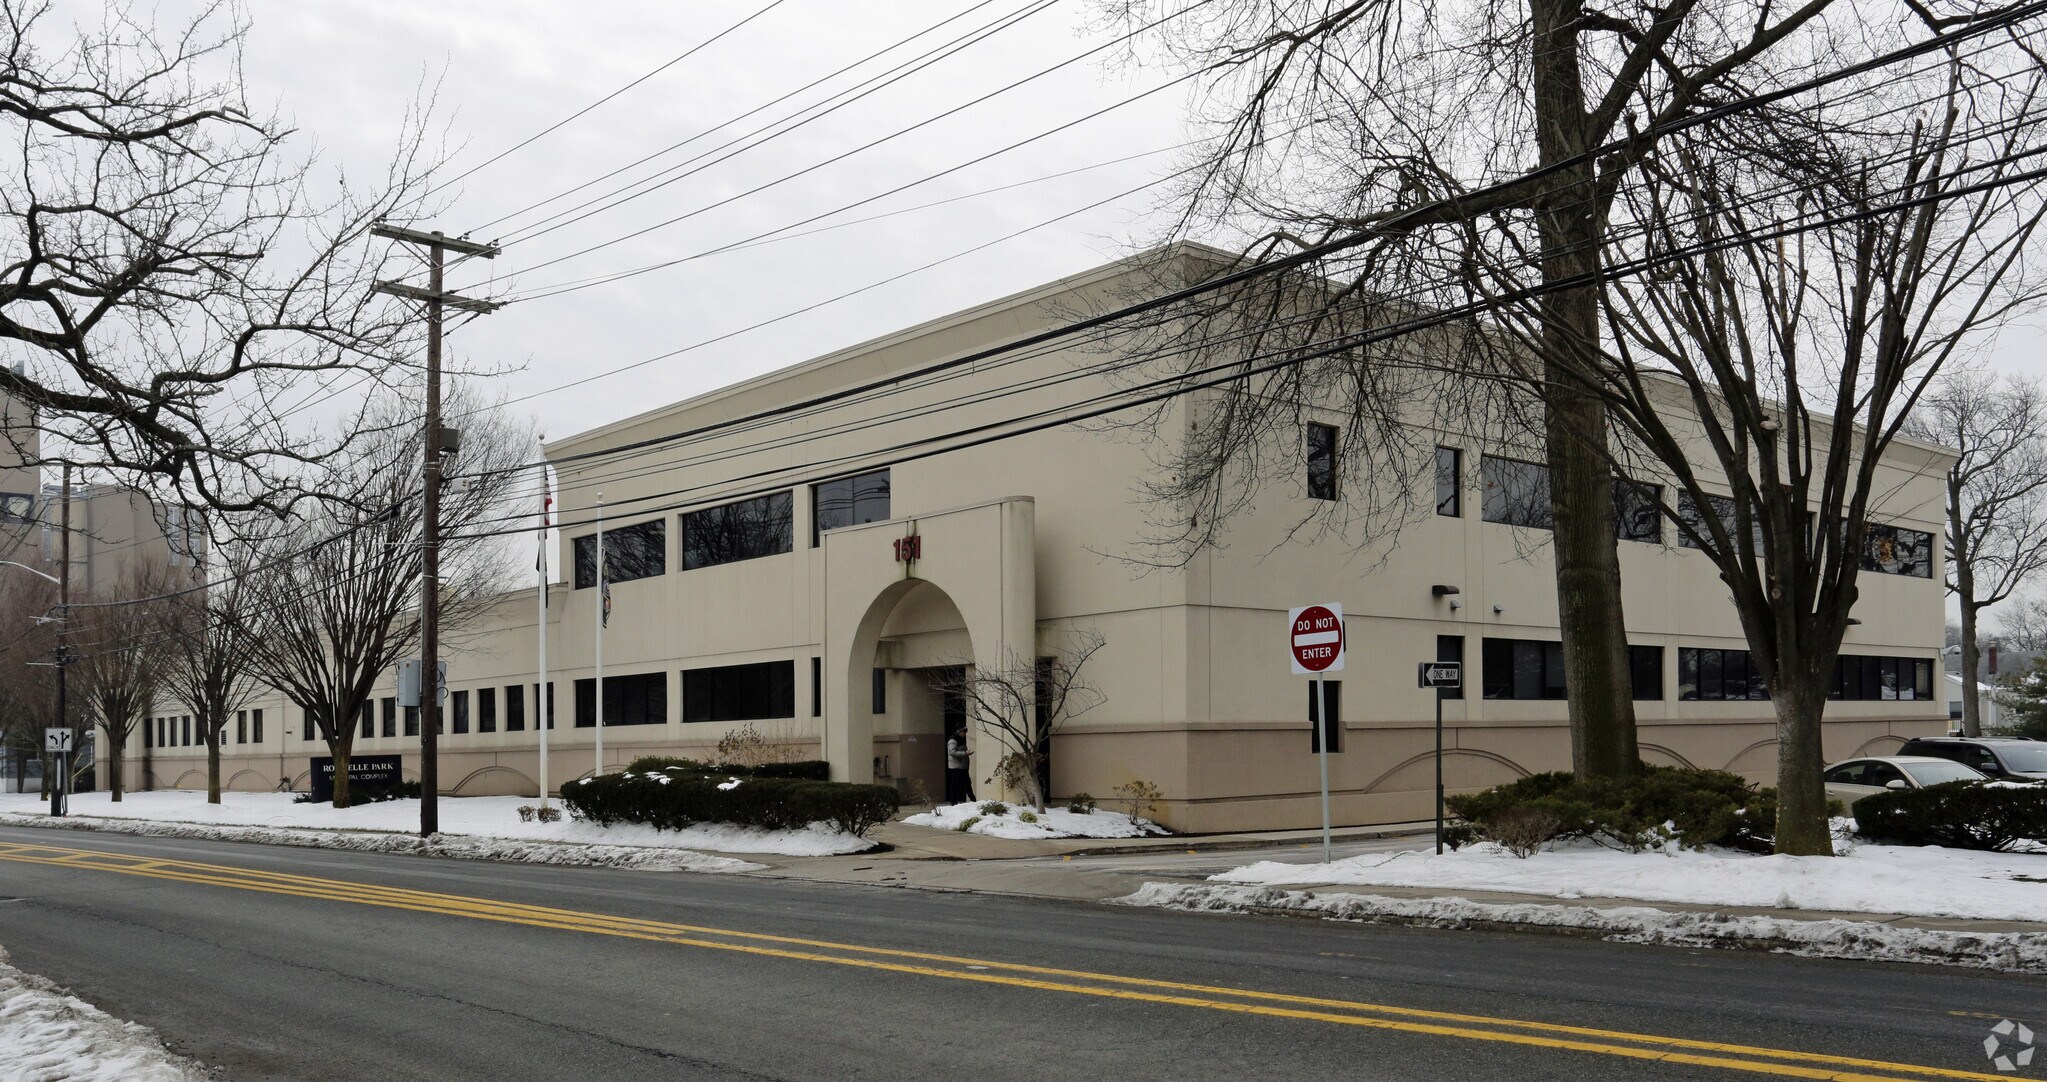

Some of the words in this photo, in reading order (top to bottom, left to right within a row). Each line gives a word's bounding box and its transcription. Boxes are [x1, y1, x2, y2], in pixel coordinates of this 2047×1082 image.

[893, 535, 921, 562] 151
[1298, 620, 1310, 631] DO
[1315, 617, 1334, 629] NOT
[1302, 647, 1332, 660] ENTER
[1433, 669, 1444, 679] ONE
[1445, 669, 1457, 679] WAY
[323, 764, 369, 772] ROELLE
